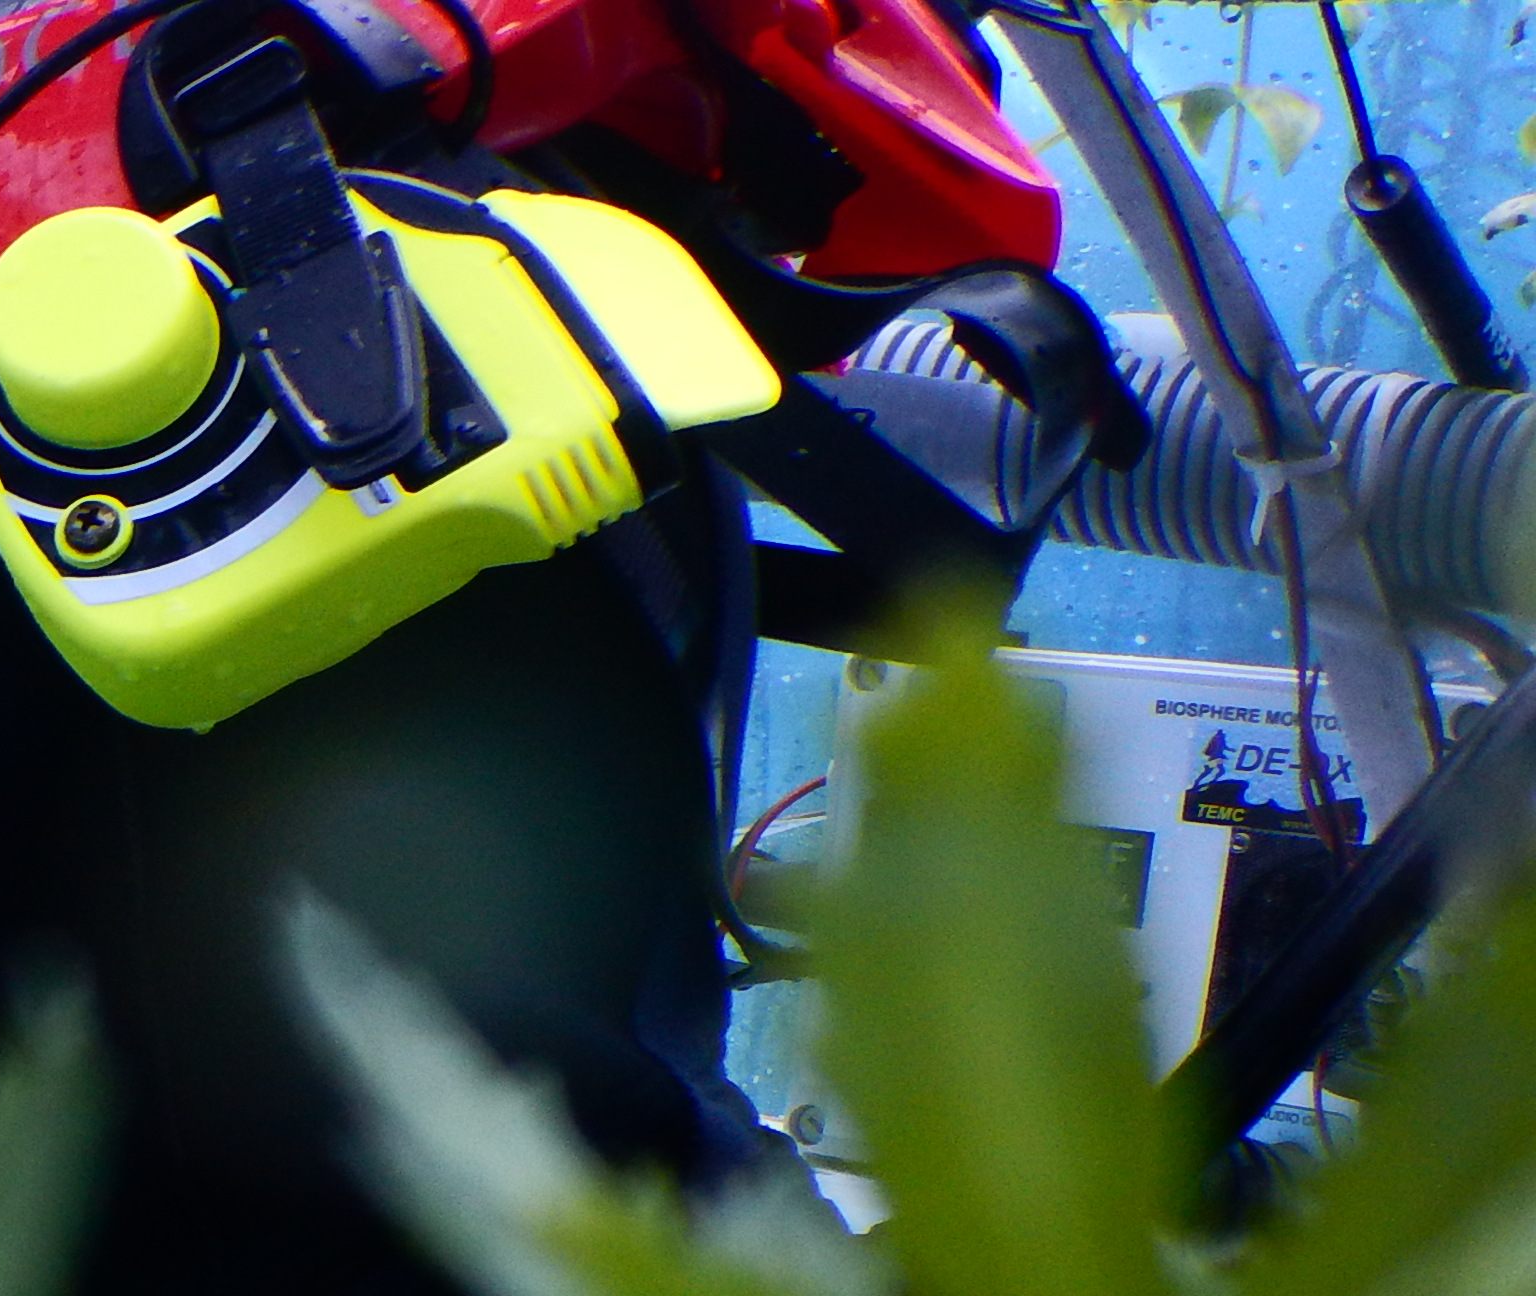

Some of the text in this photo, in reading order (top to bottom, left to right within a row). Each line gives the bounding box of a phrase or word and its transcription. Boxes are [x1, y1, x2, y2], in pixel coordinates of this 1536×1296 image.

[1155, 699, 1261, 725] BIOSPHERE
[1234, 743, 1352, 784] DE-X
[1196, 803, 1246, 822] TEMC
